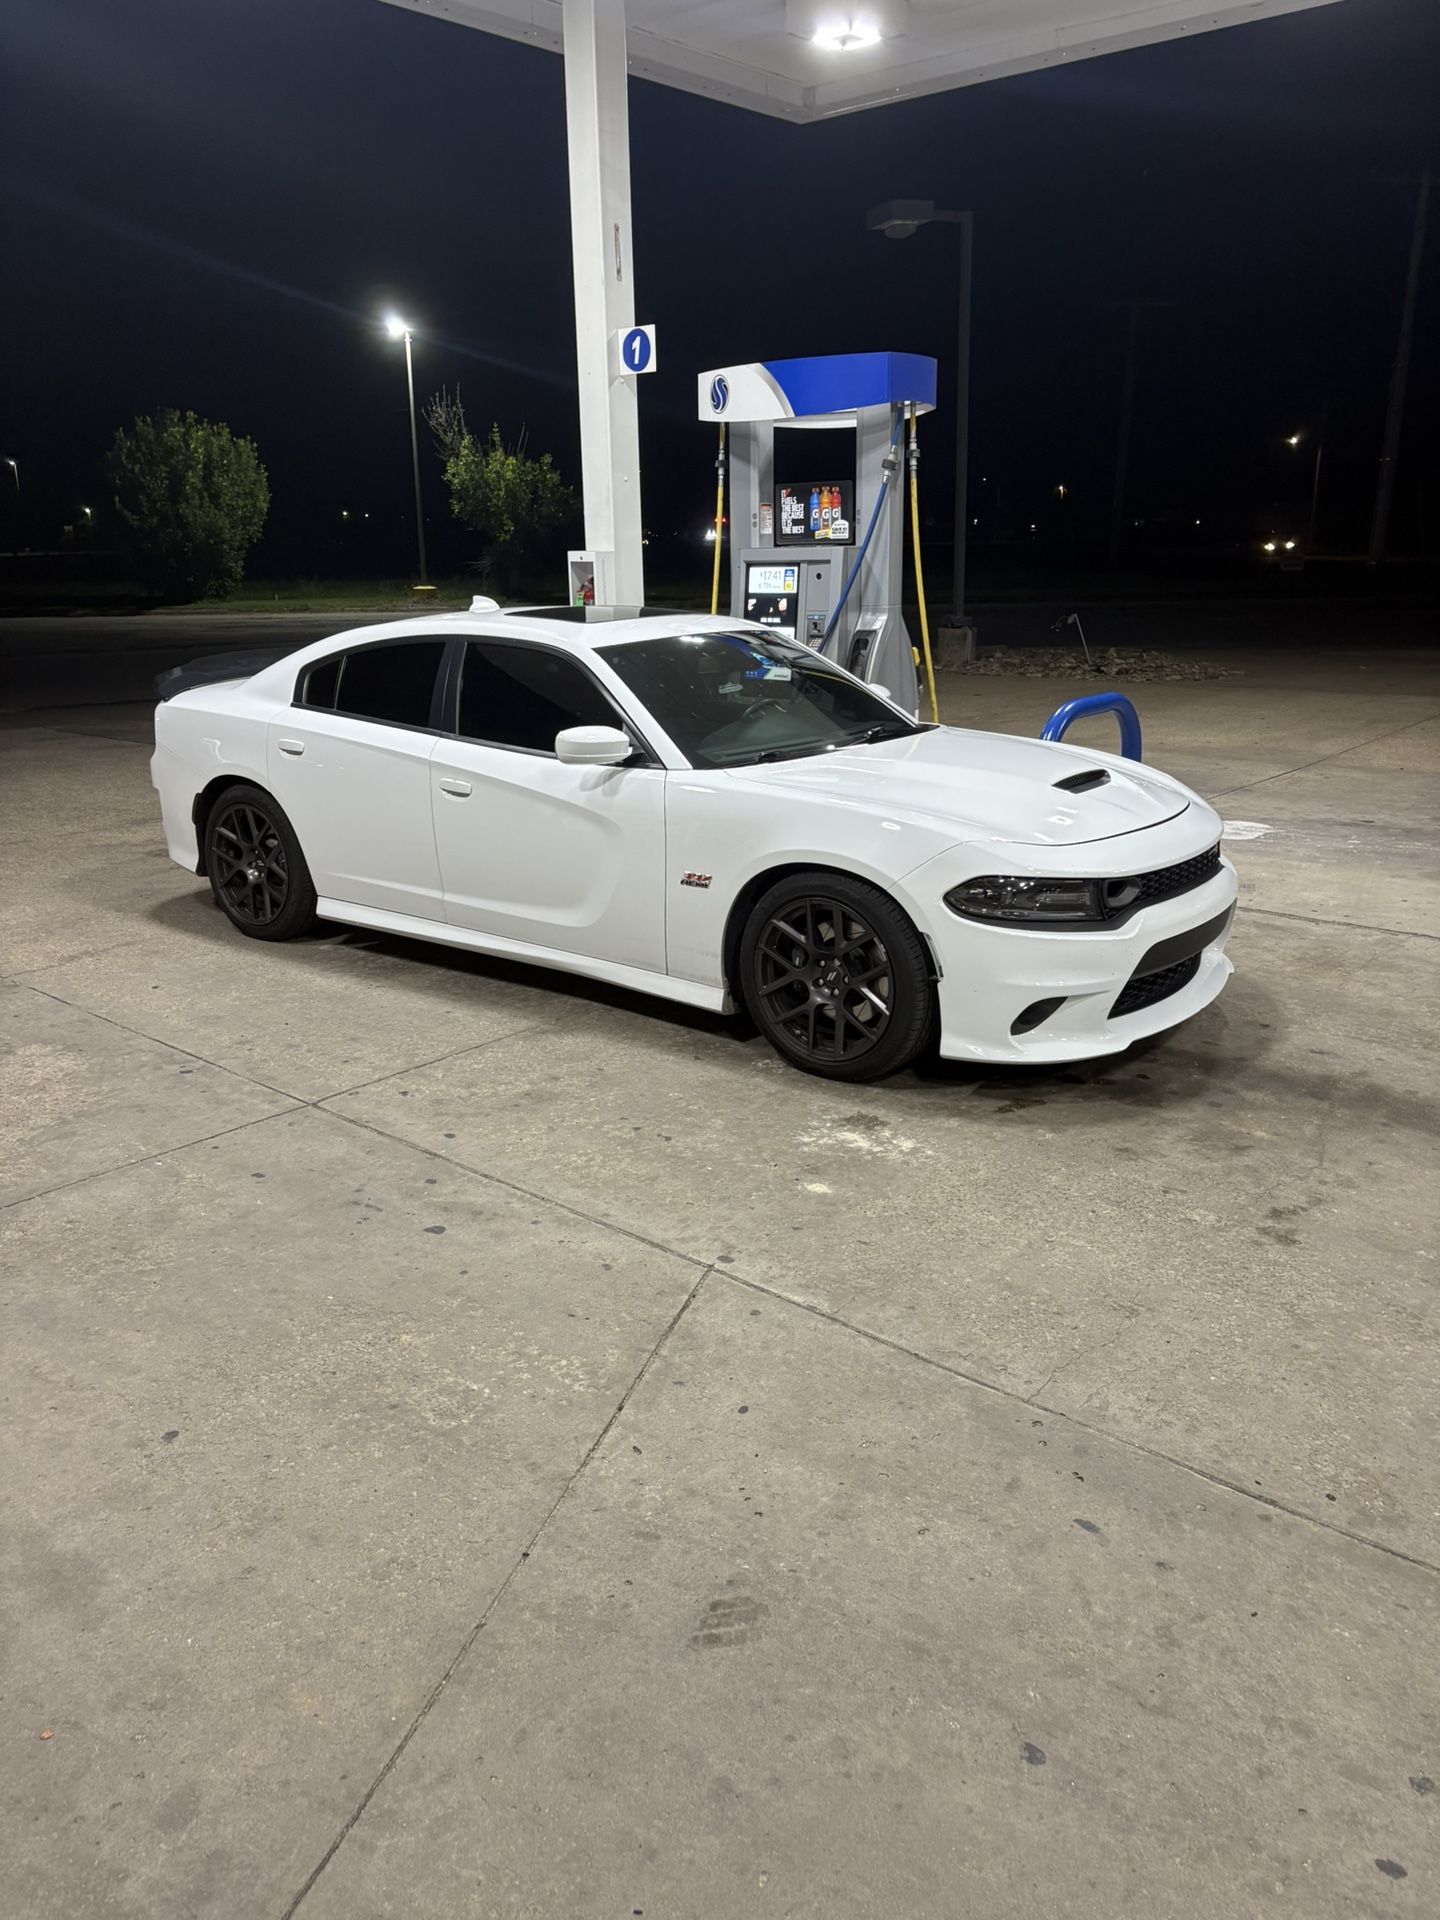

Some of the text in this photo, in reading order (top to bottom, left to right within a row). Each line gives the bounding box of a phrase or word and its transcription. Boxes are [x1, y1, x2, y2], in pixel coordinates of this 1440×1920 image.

[631, 335, 641, 365] 1
[782, 504, 804, 512] THE BEST
[812, 508, 819, 518] G
[822, 508, 829, 518] G
[832, 508, 839, 518] G
[781, 511, 804, 519] BECAUSE
[782, 525, 804, 534] THE BEST
